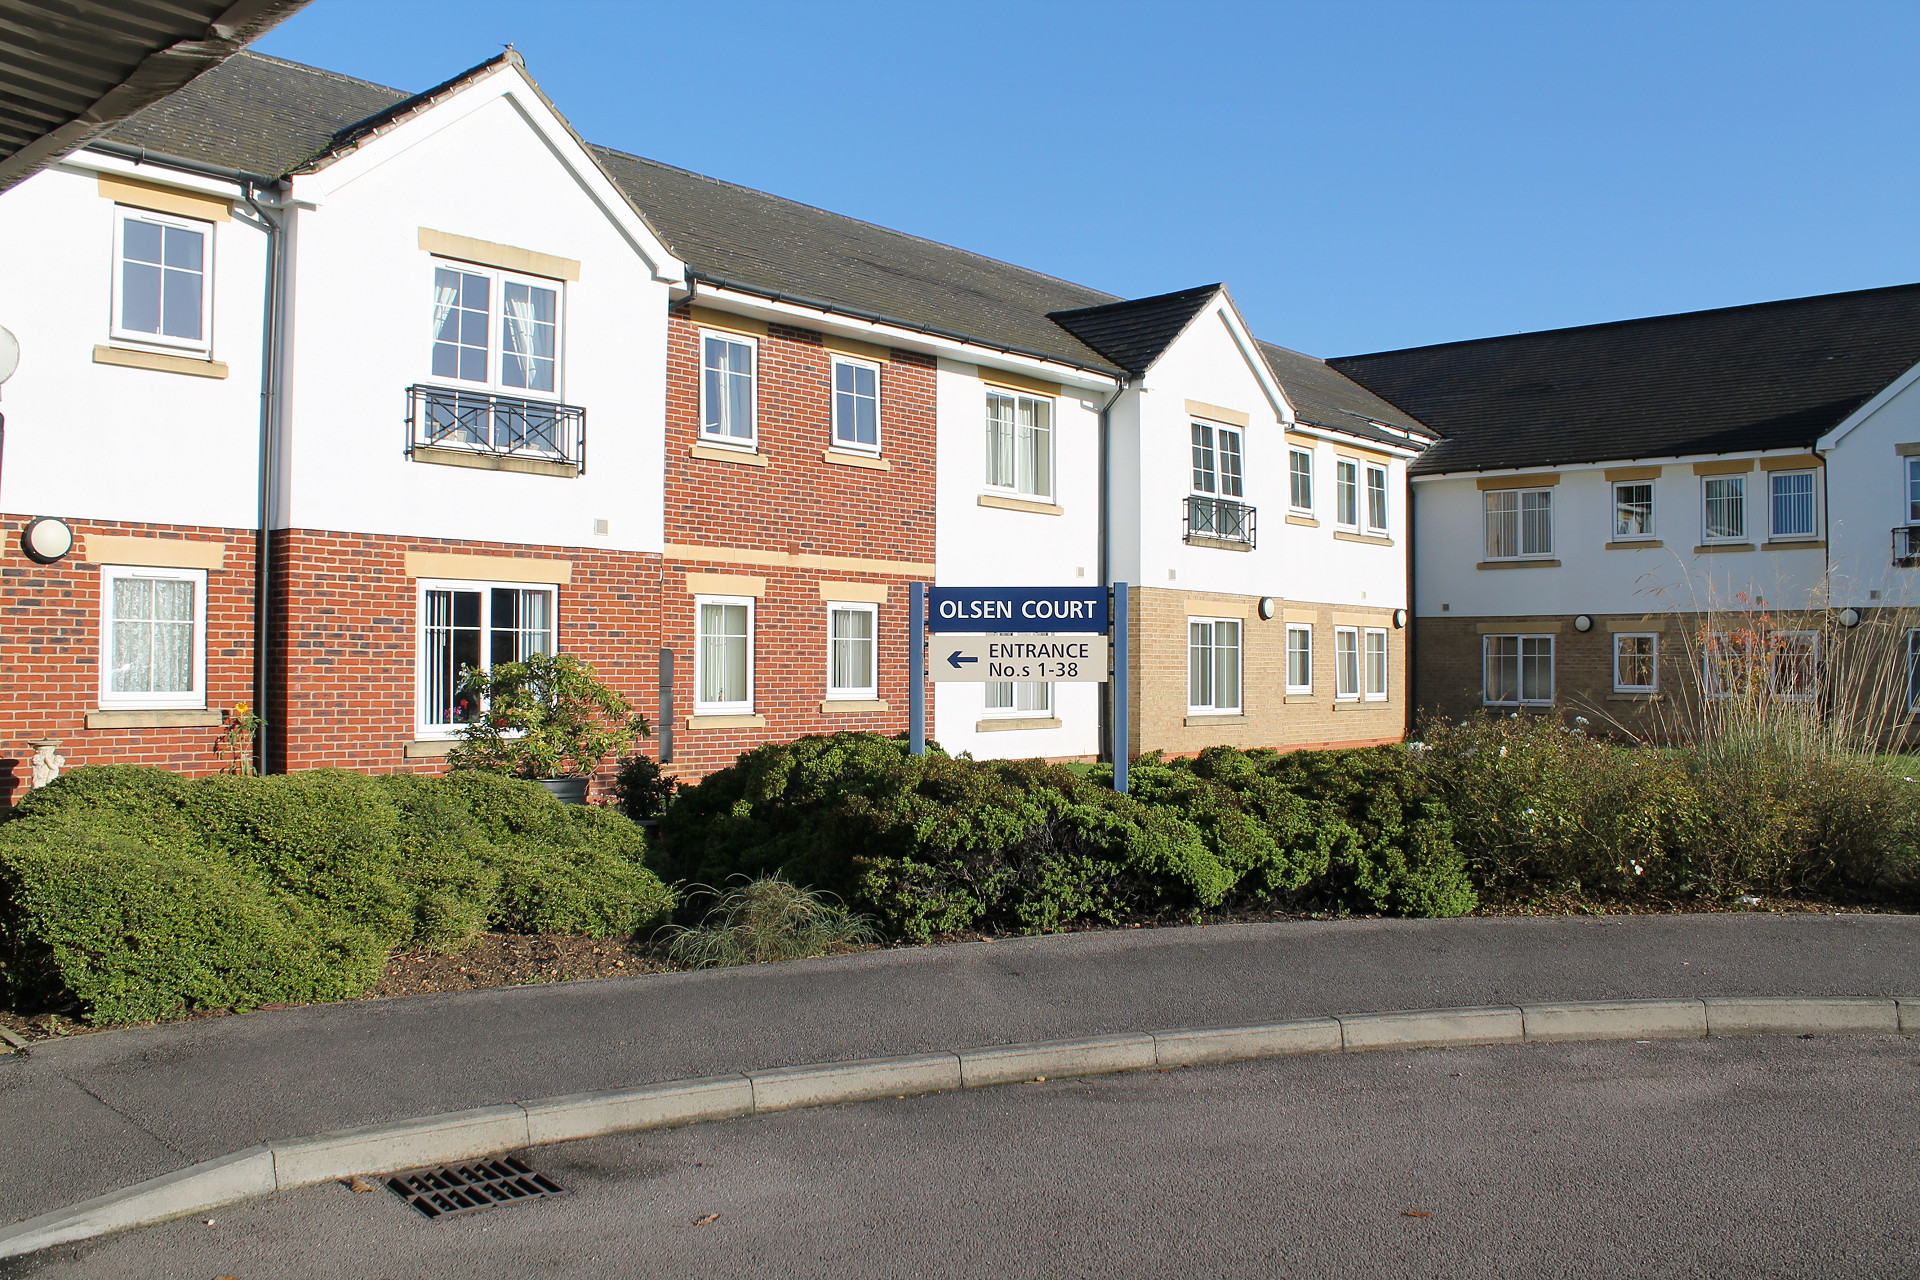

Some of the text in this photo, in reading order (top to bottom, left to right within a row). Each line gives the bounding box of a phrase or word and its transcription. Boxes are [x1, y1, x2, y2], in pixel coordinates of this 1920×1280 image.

[939, 600, 1097, 619] OLSEN COURT
[989, 643, 1089, 658] ENTRANCE
[989, 662, 1078, 677] No.s 1-38
